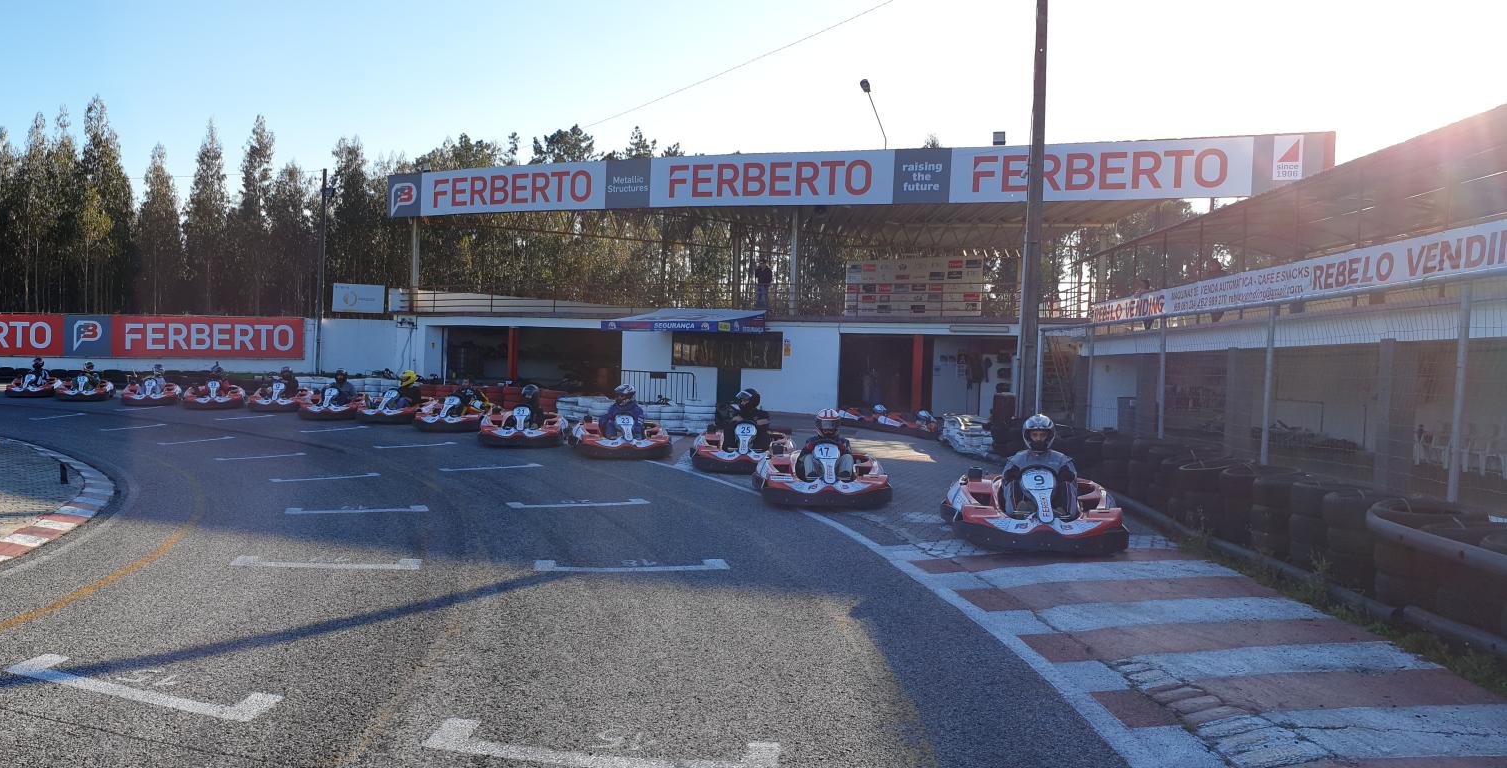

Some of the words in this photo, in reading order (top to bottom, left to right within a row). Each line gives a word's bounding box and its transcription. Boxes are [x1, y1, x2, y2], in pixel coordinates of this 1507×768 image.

[902, 161, 943, 173] raising
[972, 148, 1229, 193] FERBERTO
[613, 176, 644, 184] Metallic
[668, 159, 872, 198] FERBERTO
[912, 172, 932, 181] the
[432, 169, 592, 208] FERBERTO
[607, 184, 649, 193] Structures
[903, 182, 940, 191] future
[1312, 251, 1395, 290] REBELO
[1126, 295, 1165, 318] VENDING
[653, 322, 695, 330] SEGURANÇA
[124, 322, 294, 351] FERBERTO
[741, 426, 751, 434] 25
[818, 446, 830, 457] 17
[1033, 474, 1045, 485] 9
